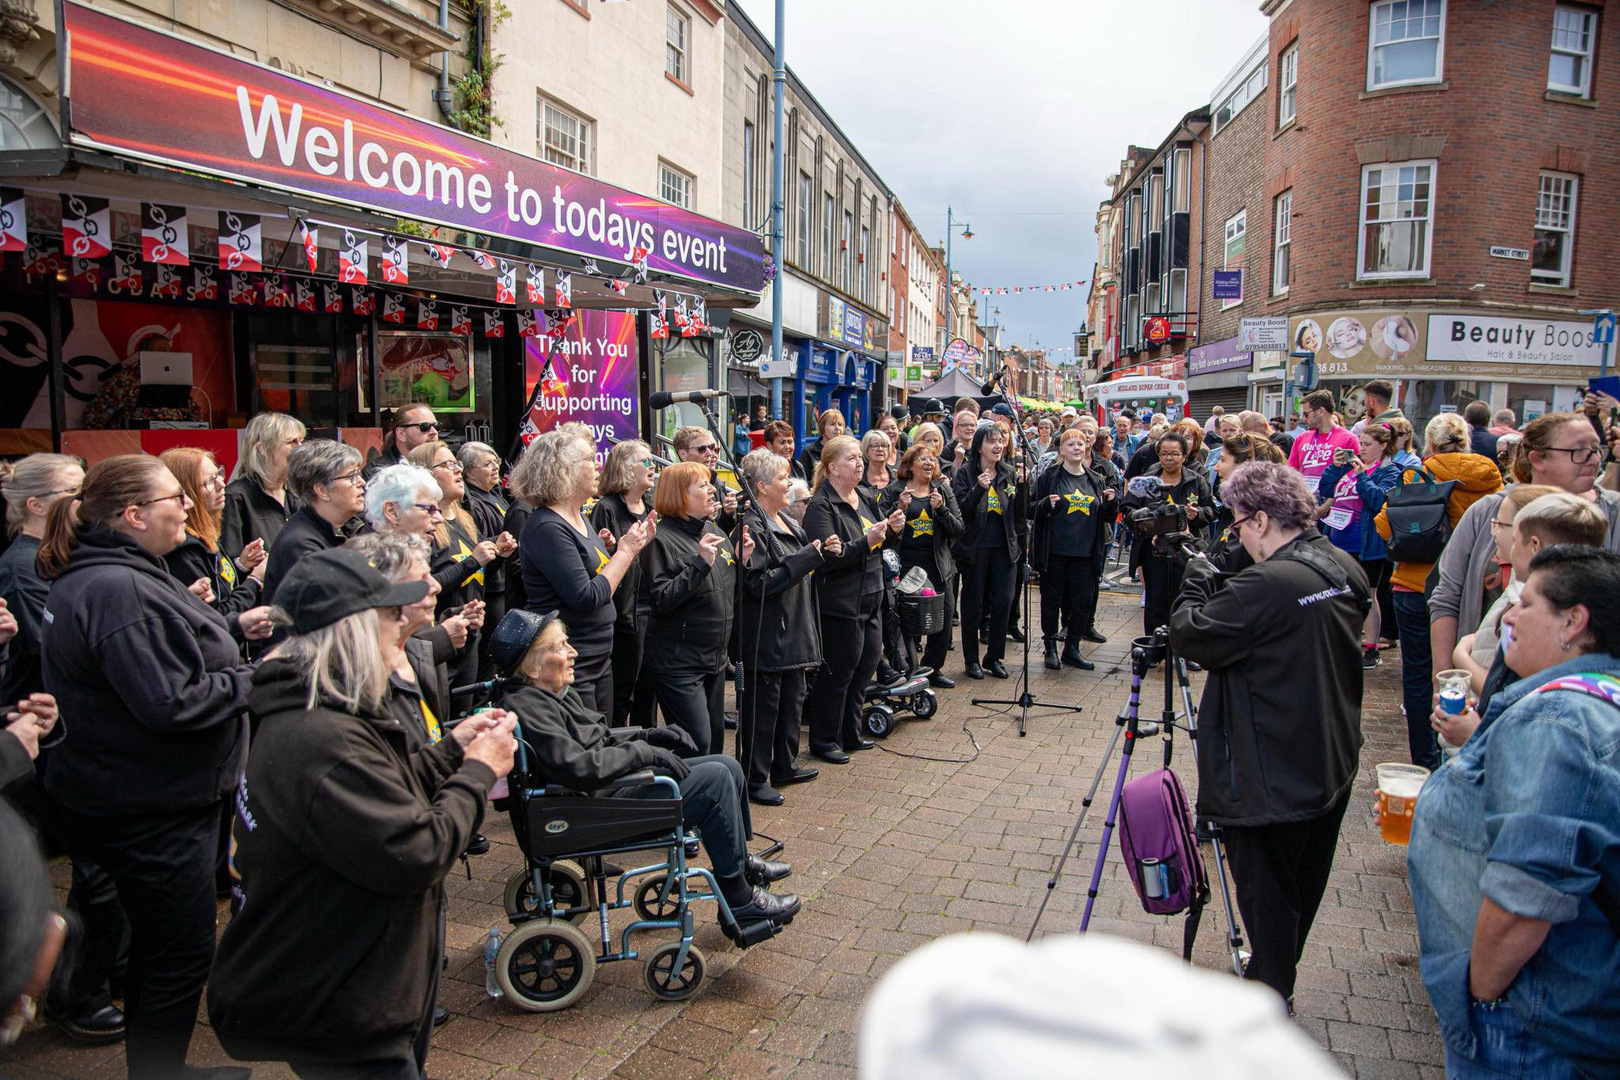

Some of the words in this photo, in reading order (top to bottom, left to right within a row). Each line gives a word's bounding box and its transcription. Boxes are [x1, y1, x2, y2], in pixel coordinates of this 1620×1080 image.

[236, 85, 493, 215] Welcome
[504, 170, 543, 226] to
[552, 184, 655, 260] todays
[662, 229, 728, 274] event
[1492, 247, 1510, 257] MARKET
[1511, 250, 1528, 259] STREET
[1451, 321, 1536, 350] Beauty
[1544, 324, 1601, 349] Boos
[597, 338, 628, 358] You
[1487, 350, 1505, 359] Hair
[1508, 350, 1515, 358] &
[1517, 351, 1547, 362] Beauty
[1549, 352, 1573, 362] Salon
[571, 364, 597, 383] for
[1329, 362, 1348, 373] 813
[1138, 383, 1153, 391] SUPER
[1070, 494, 1090, 502] ROCK
[1069, 501, 1091, 509] CHOIR
